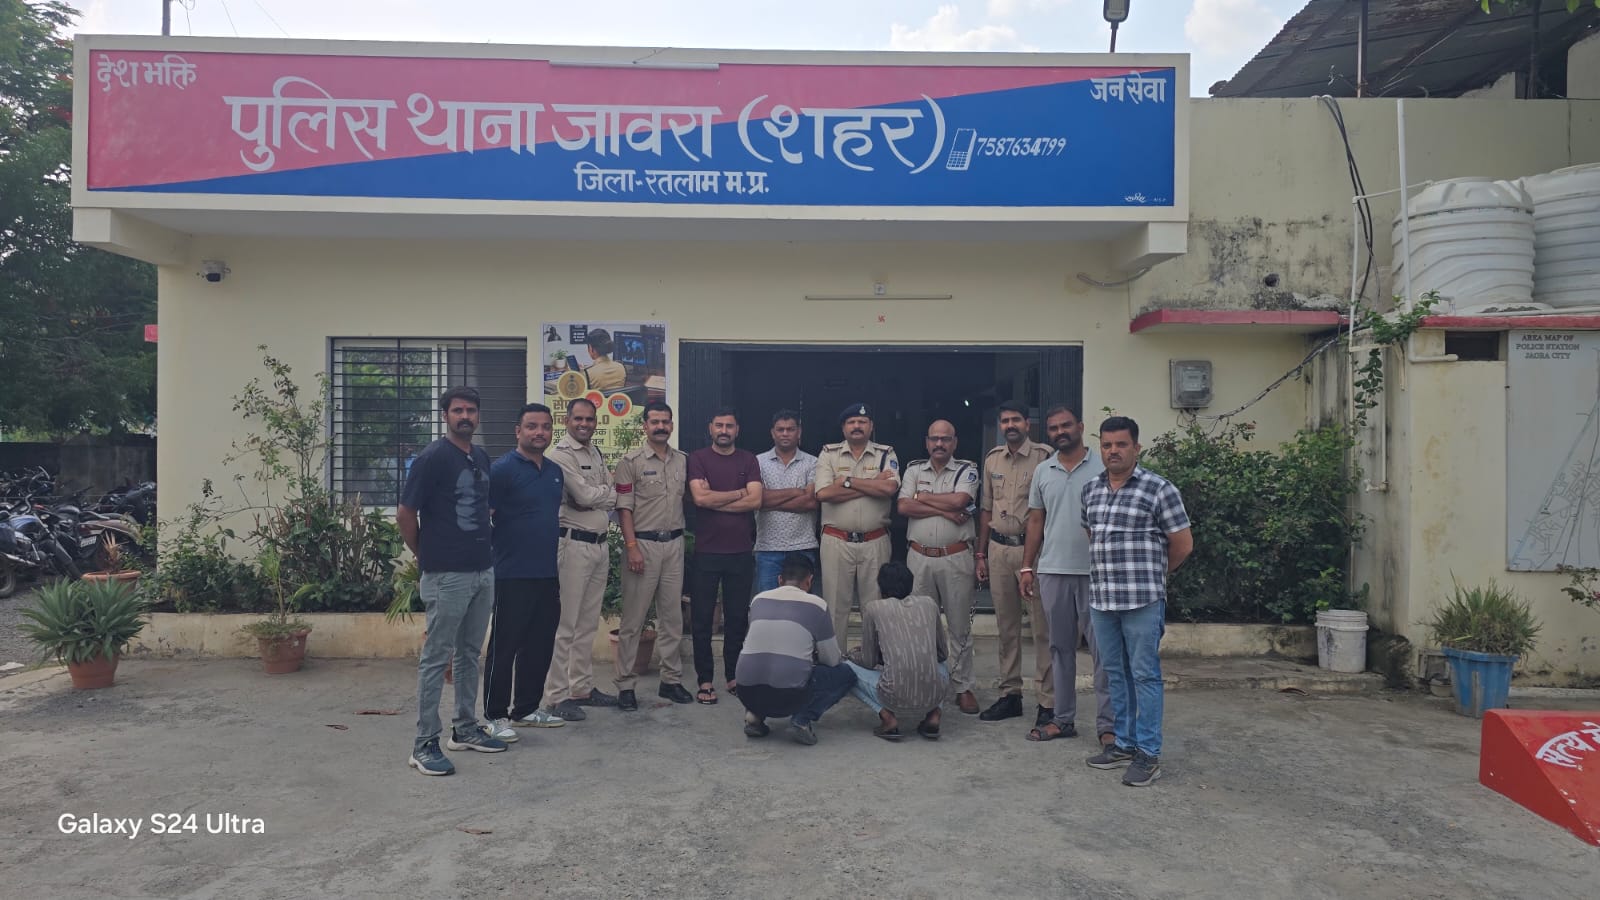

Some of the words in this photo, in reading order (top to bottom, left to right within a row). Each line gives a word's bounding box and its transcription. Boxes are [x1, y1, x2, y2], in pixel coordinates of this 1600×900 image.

[223, 75, 398, 172] पुलिस
[407, 92, 546, 156] थाना
[551, 102, 722, 162] जावरा
[737, 93, 946, 175] (शहर)
[977, 137, 1067, 157] 7587634799
[1521, 334, 1543, 342] AREA
[1544, 334, 1561, 342] MAP
[1563, 334, 1575, 342] OF
[1551, 352, 1572, 360] CITY
